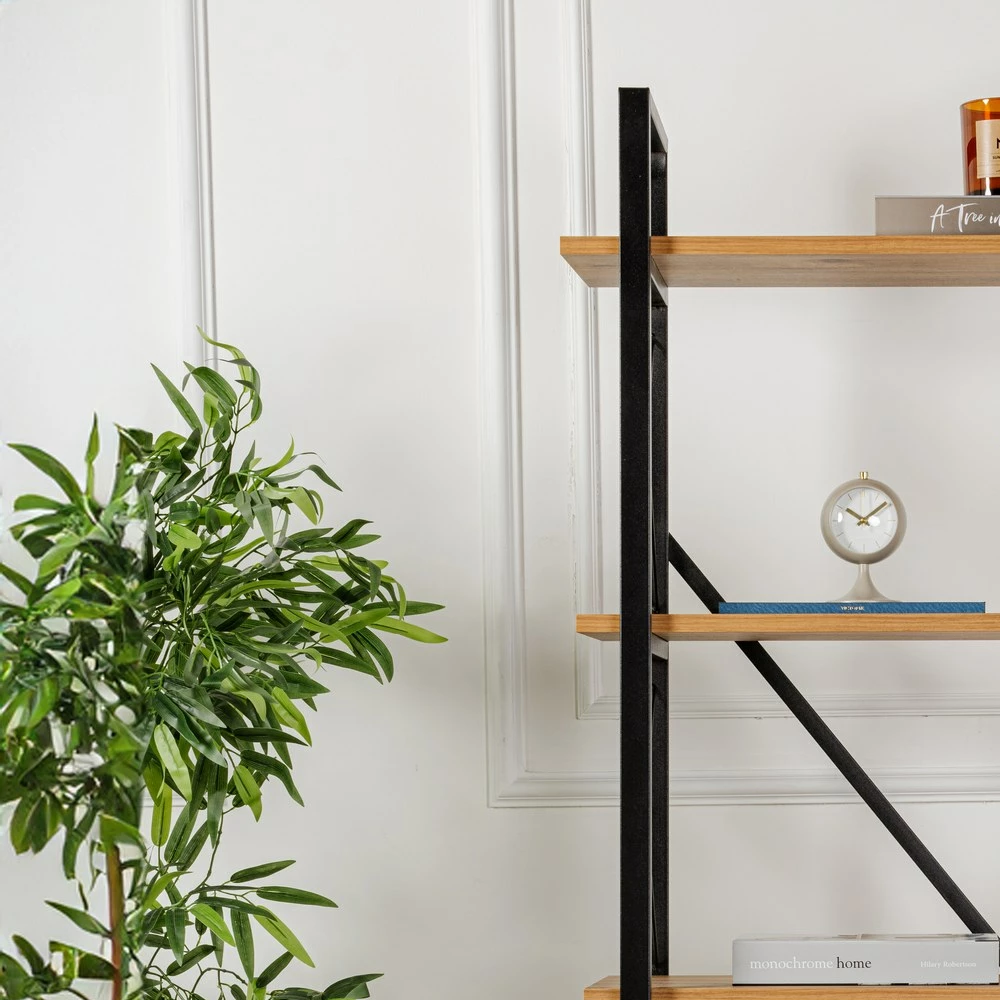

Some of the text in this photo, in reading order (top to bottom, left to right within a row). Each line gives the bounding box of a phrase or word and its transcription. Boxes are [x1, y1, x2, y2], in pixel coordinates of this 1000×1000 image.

[930, 203, 949, 233] A
[945, 202, 986, 233] Tree
[750, 956, 872, 970] monochrome home
